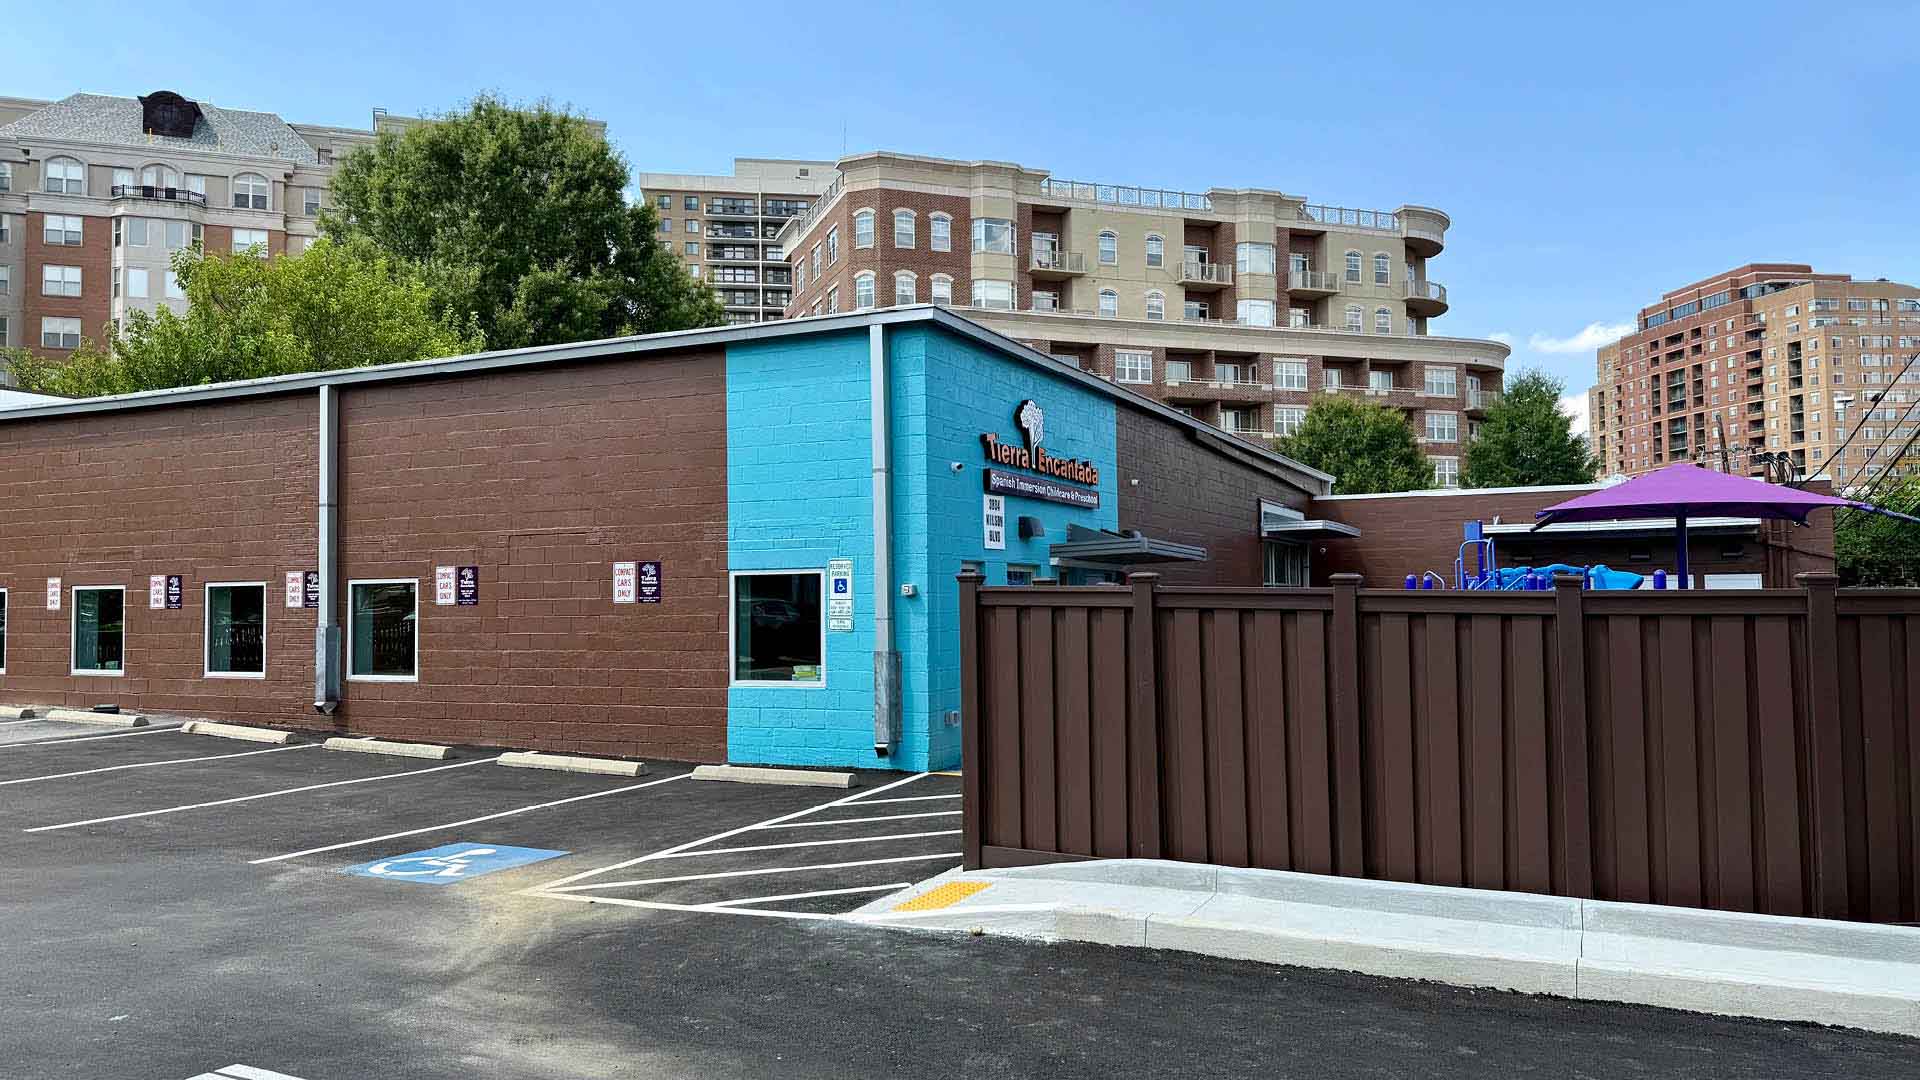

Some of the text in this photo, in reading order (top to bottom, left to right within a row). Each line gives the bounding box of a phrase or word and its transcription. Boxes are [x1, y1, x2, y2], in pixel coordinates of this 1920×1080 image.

[985, 432, 1099, 485] Tierra Encantada
[991, 473, 1016, 488] Spanish
[1016, 478, 1047, 494] Immersion
[1047, 486, 1071, 500] Childcare
[1075, 492, 1099, 505] Preschool
[986, 513, 1003, 527] WILSON
[615, 568, 635, 576] COMPACT
[440, 582, 452, 590] CARS
[617, 579, 631, 587] CARS
[440, 592, 452, 600] ONLY
